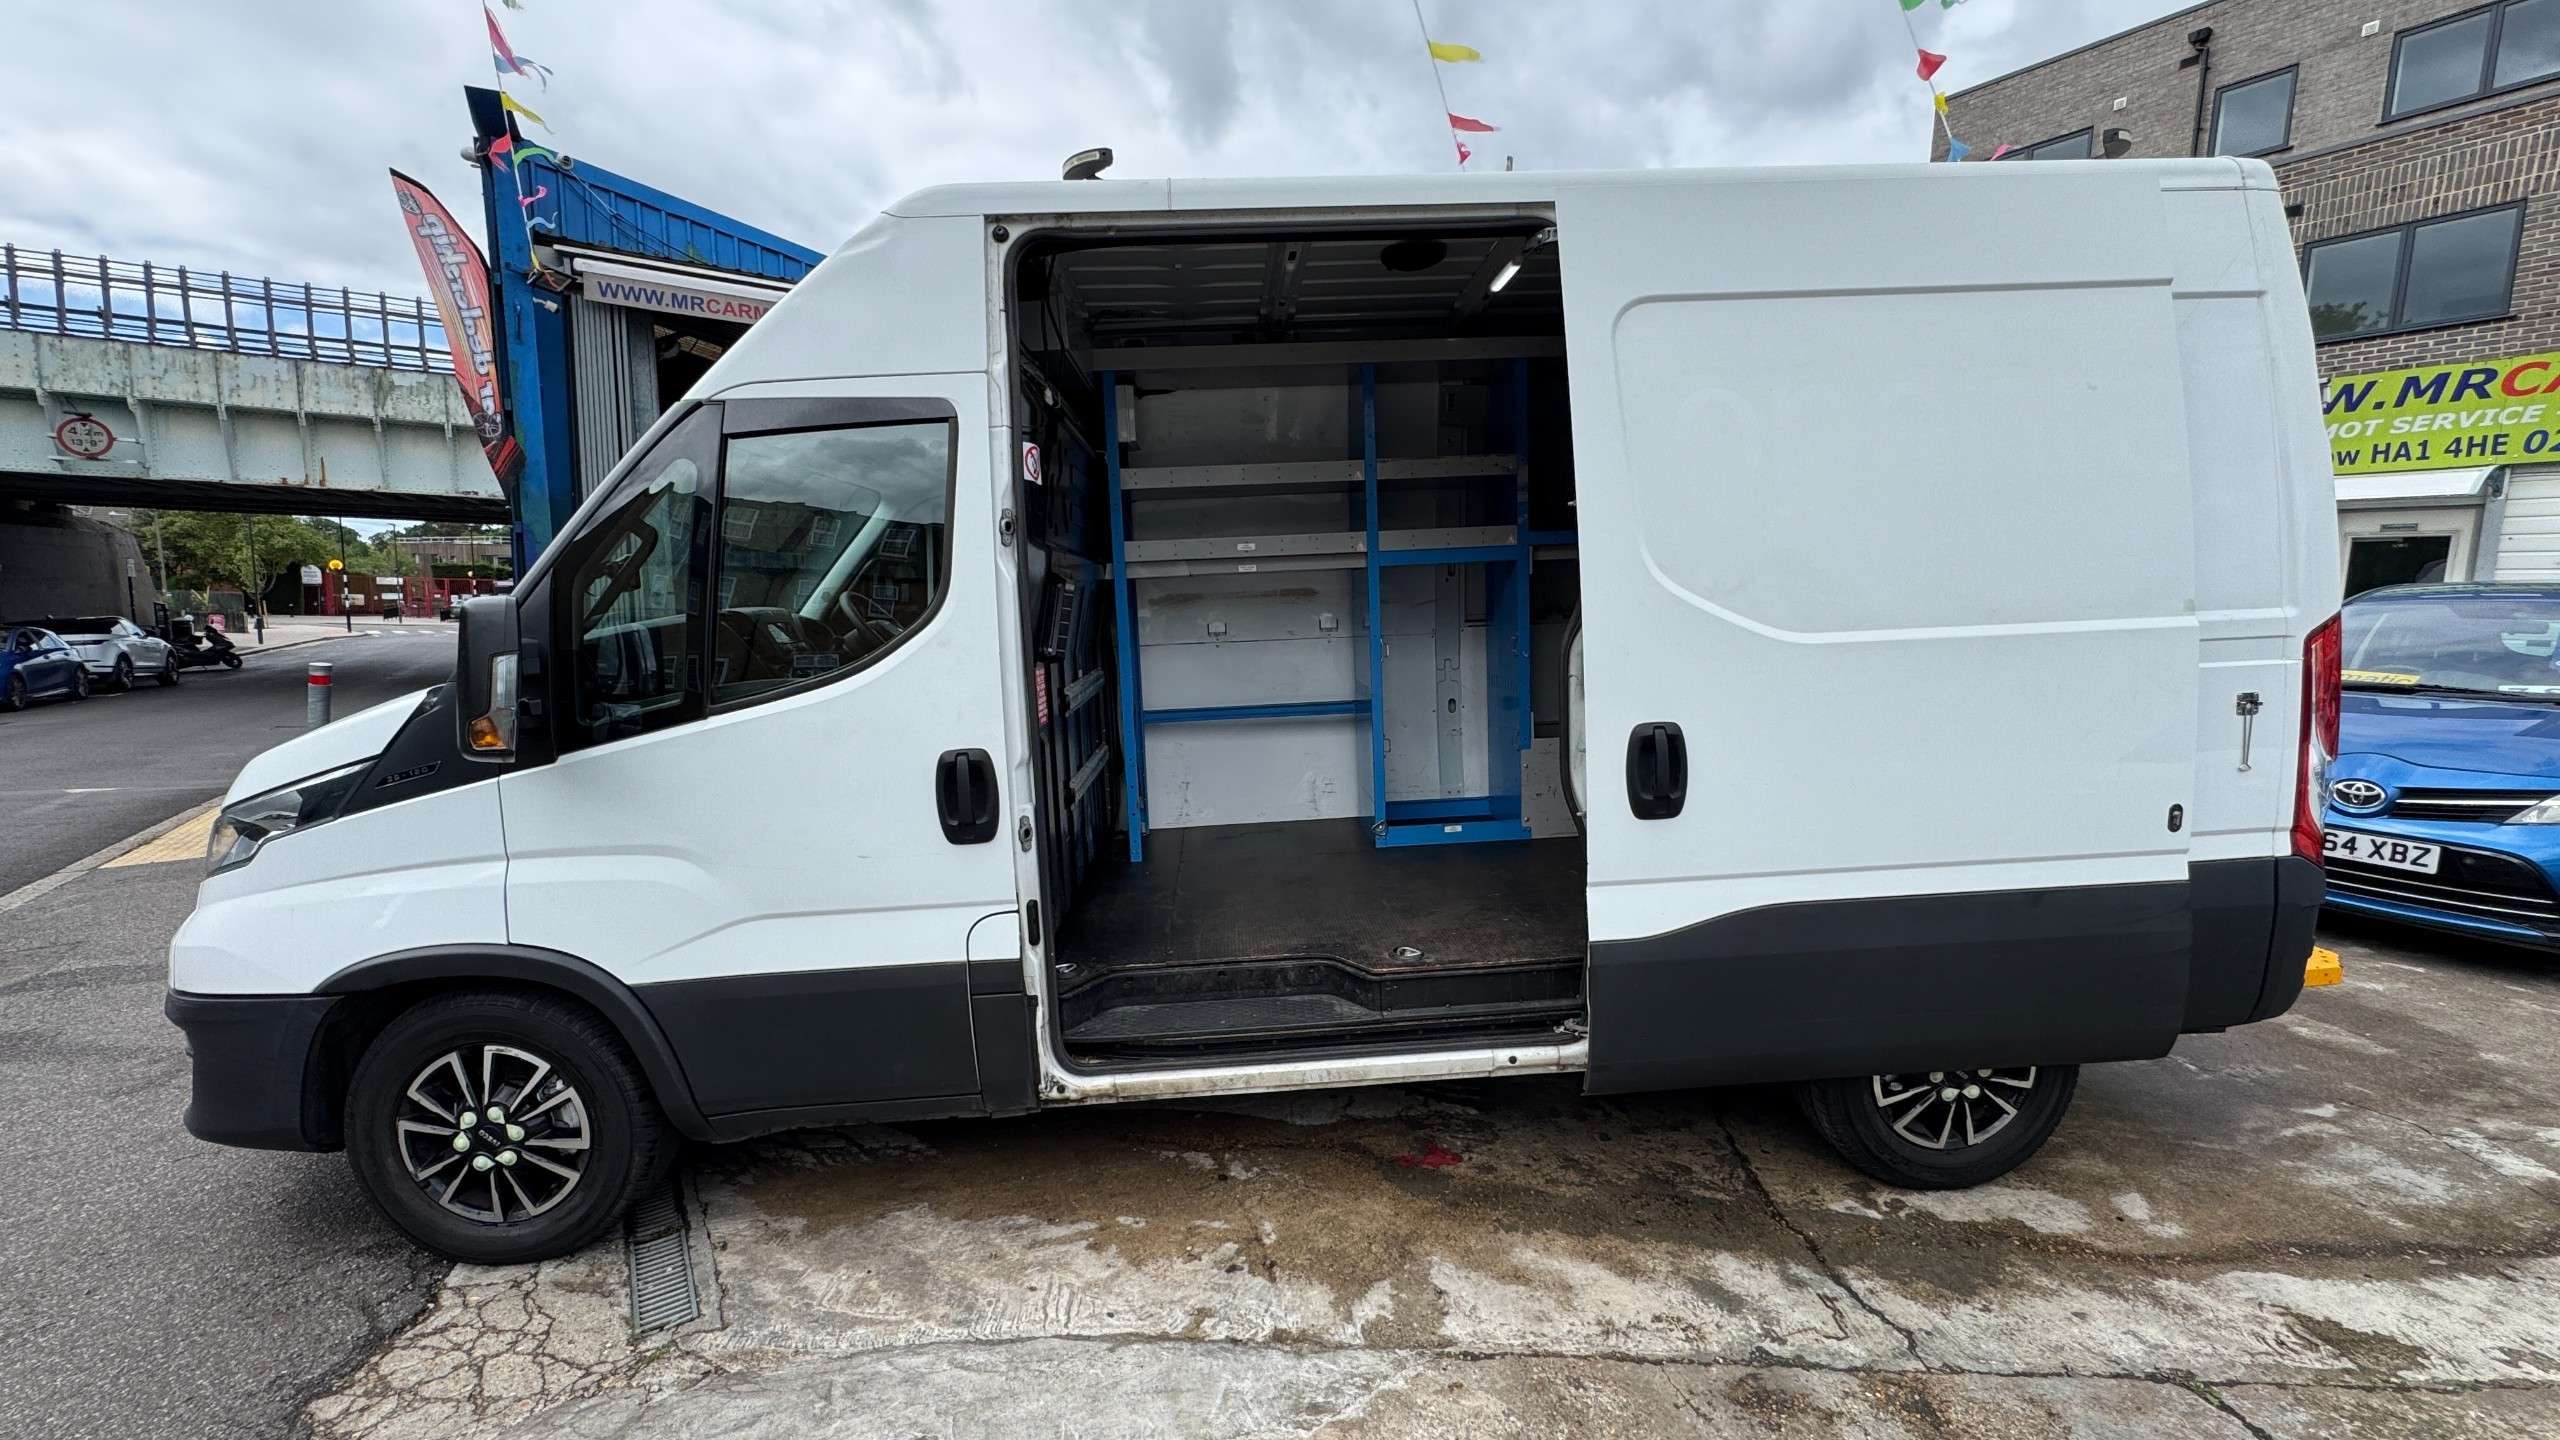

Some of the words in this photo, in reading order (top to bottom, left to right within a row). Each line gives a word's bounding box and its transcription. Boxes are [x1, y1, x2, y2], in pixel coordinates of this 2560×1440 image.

[2389, 404, 2547, 434] SERVICE
[2371, 440, 2431, 464] HA1
[2444, 433, 2510, 459] 4HE
[2324, 832, 2358, 855] 64
[2367, 839, 2432, 868] XBZ
